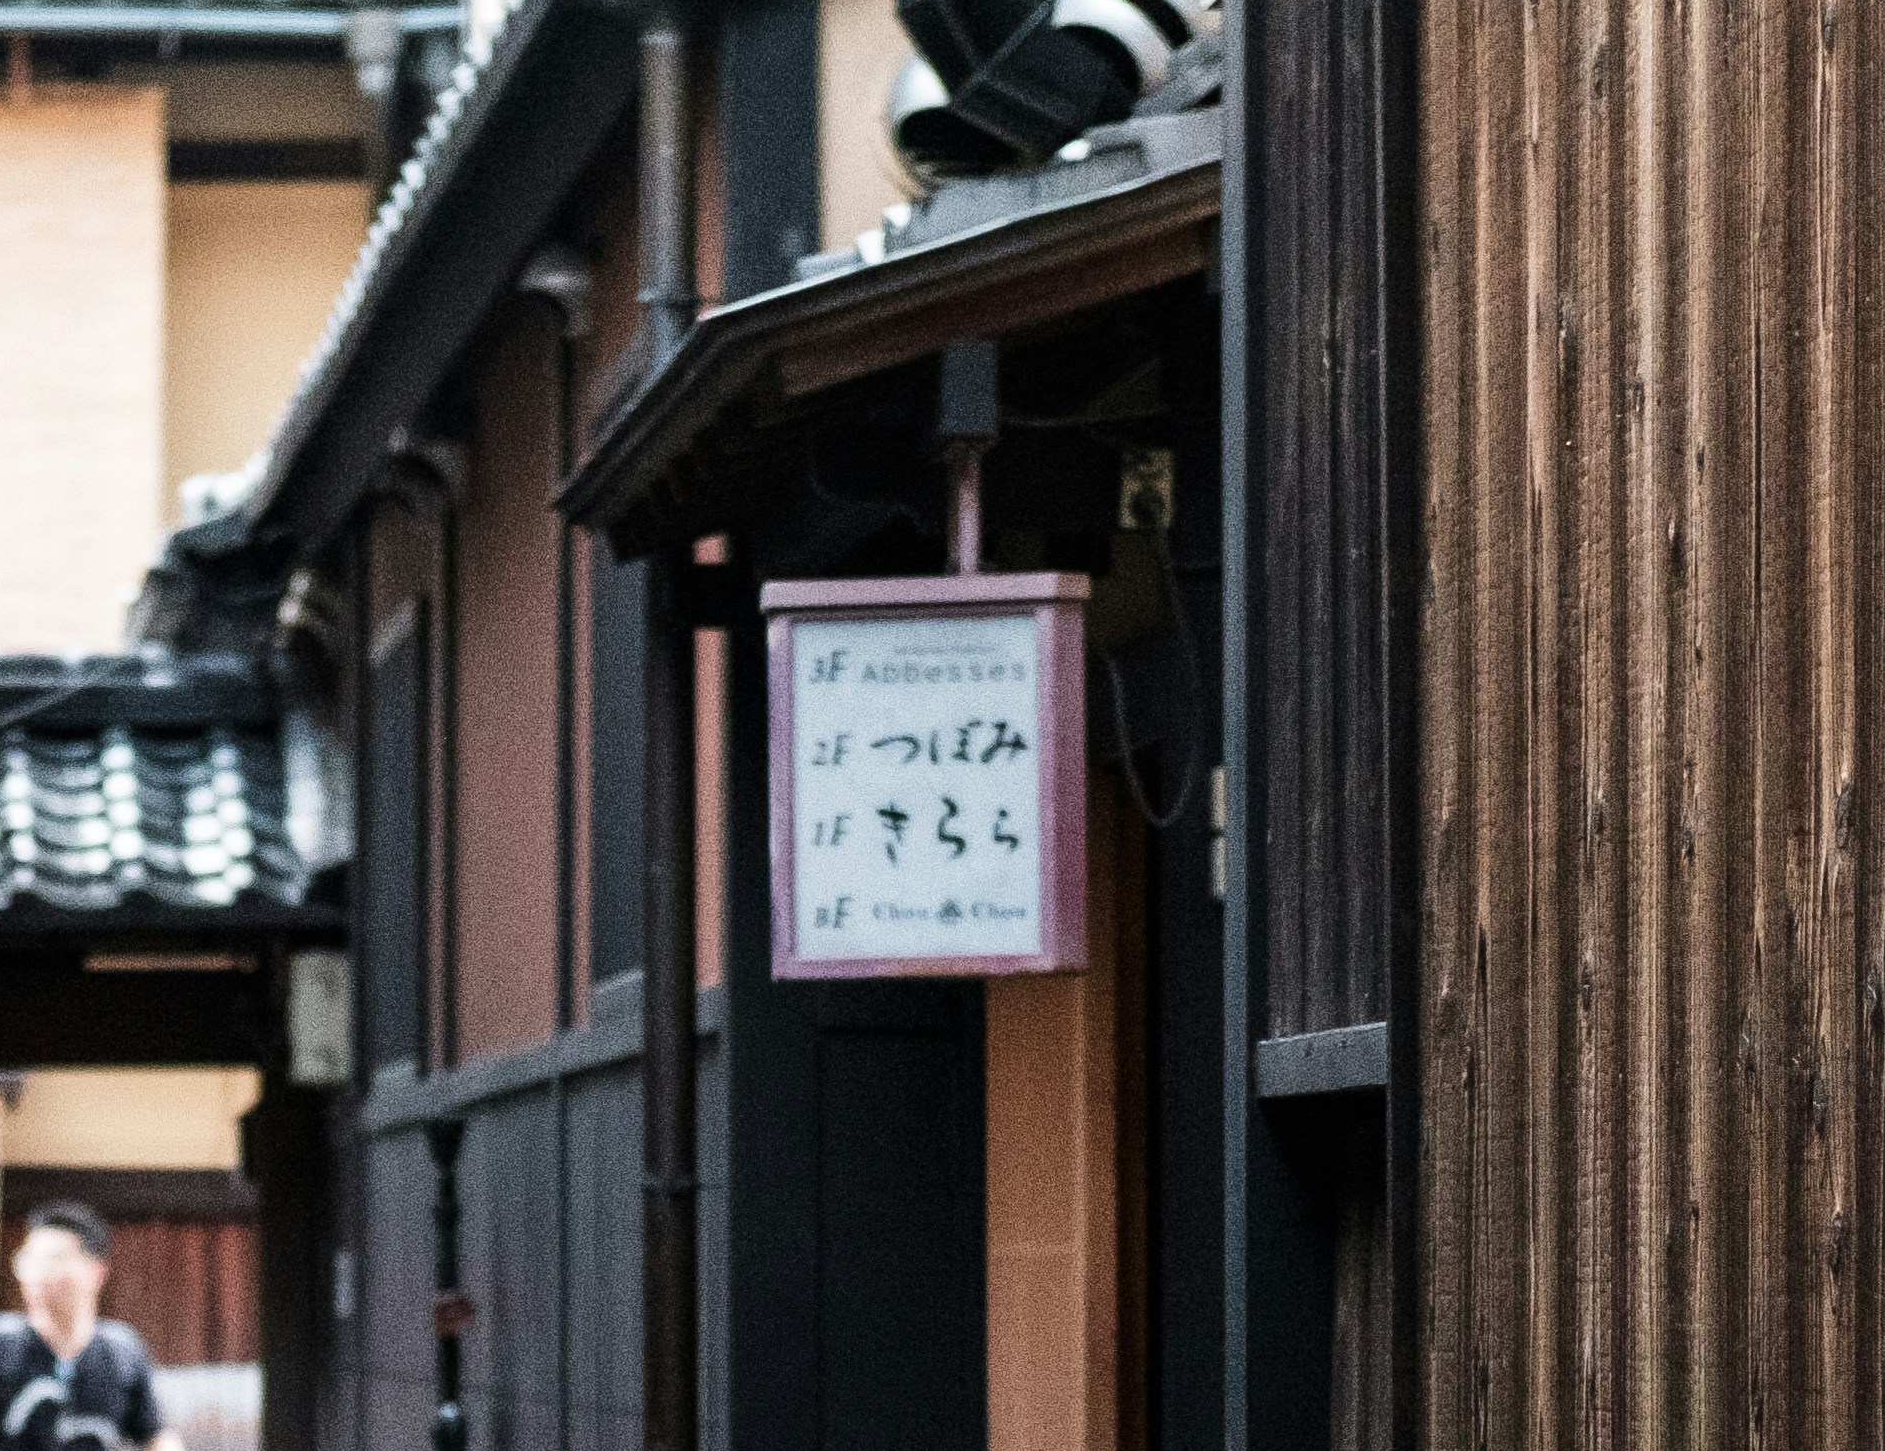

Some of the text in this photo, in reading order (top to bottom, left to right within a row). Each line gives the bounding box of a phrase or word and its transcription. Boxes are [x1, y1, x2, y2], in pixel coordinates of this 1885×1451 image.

[811, 718, 1029, 766] 2F つぼみ
[811, 814, 852, 847] 1F
